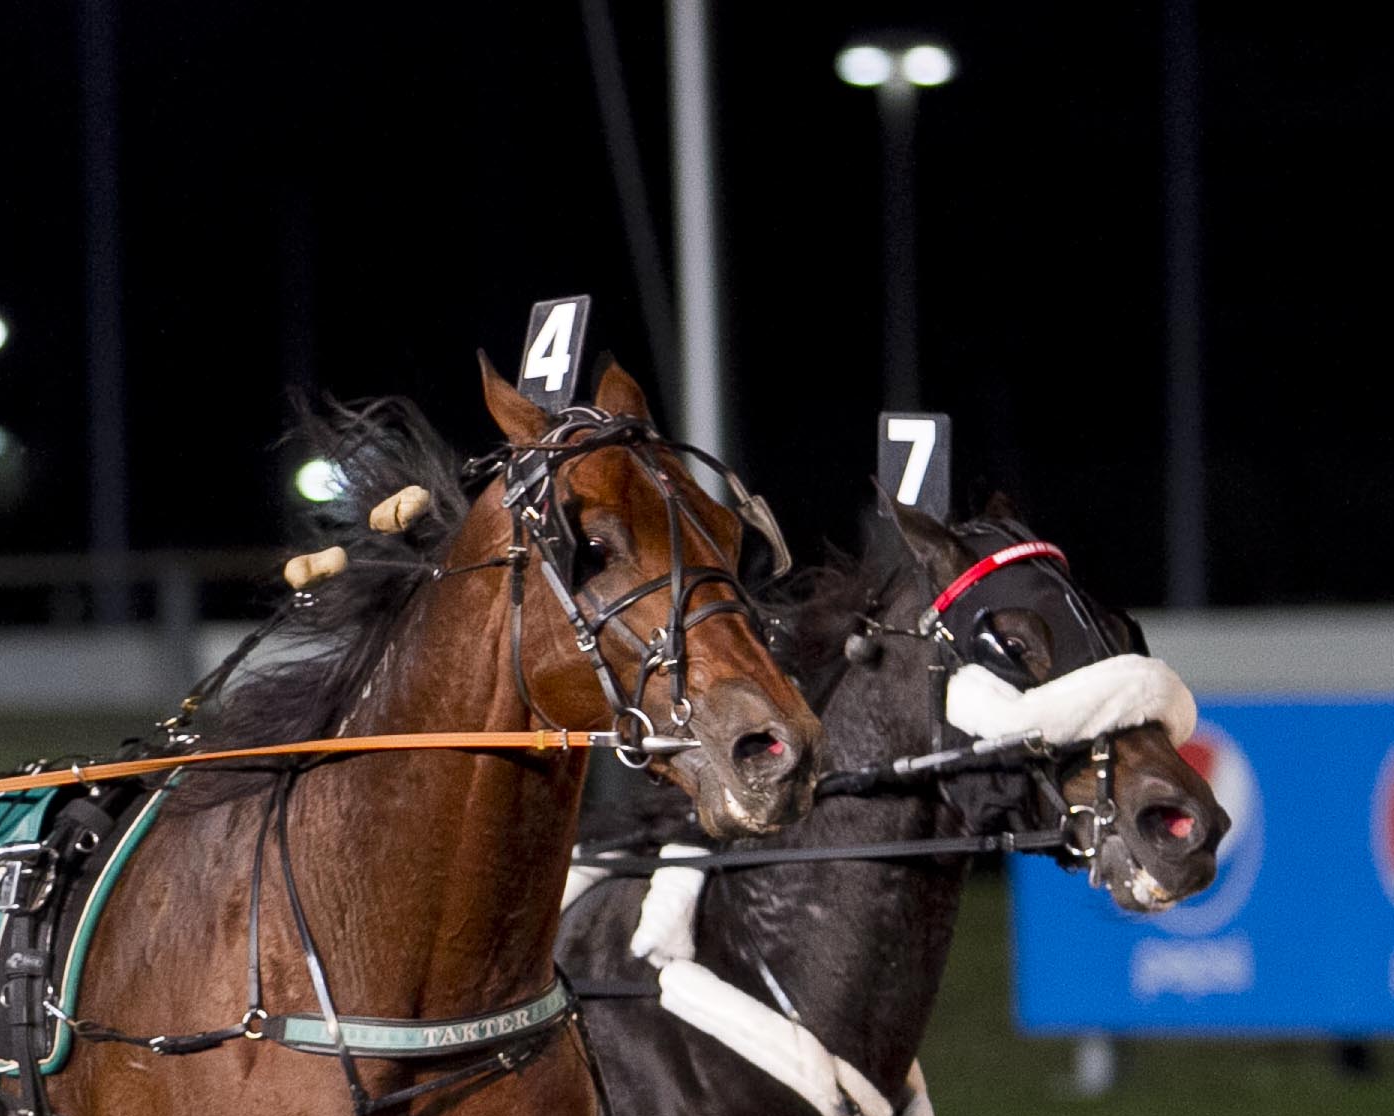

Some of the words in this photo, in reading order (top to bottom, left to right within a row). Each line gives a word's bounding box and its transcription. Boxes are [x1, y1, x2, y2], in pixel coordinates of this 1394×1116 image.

[524, 302, 577, 392] 4
[888, 418, 936, 506] 7
[422, 1009, 530, 1047] TAKTER
